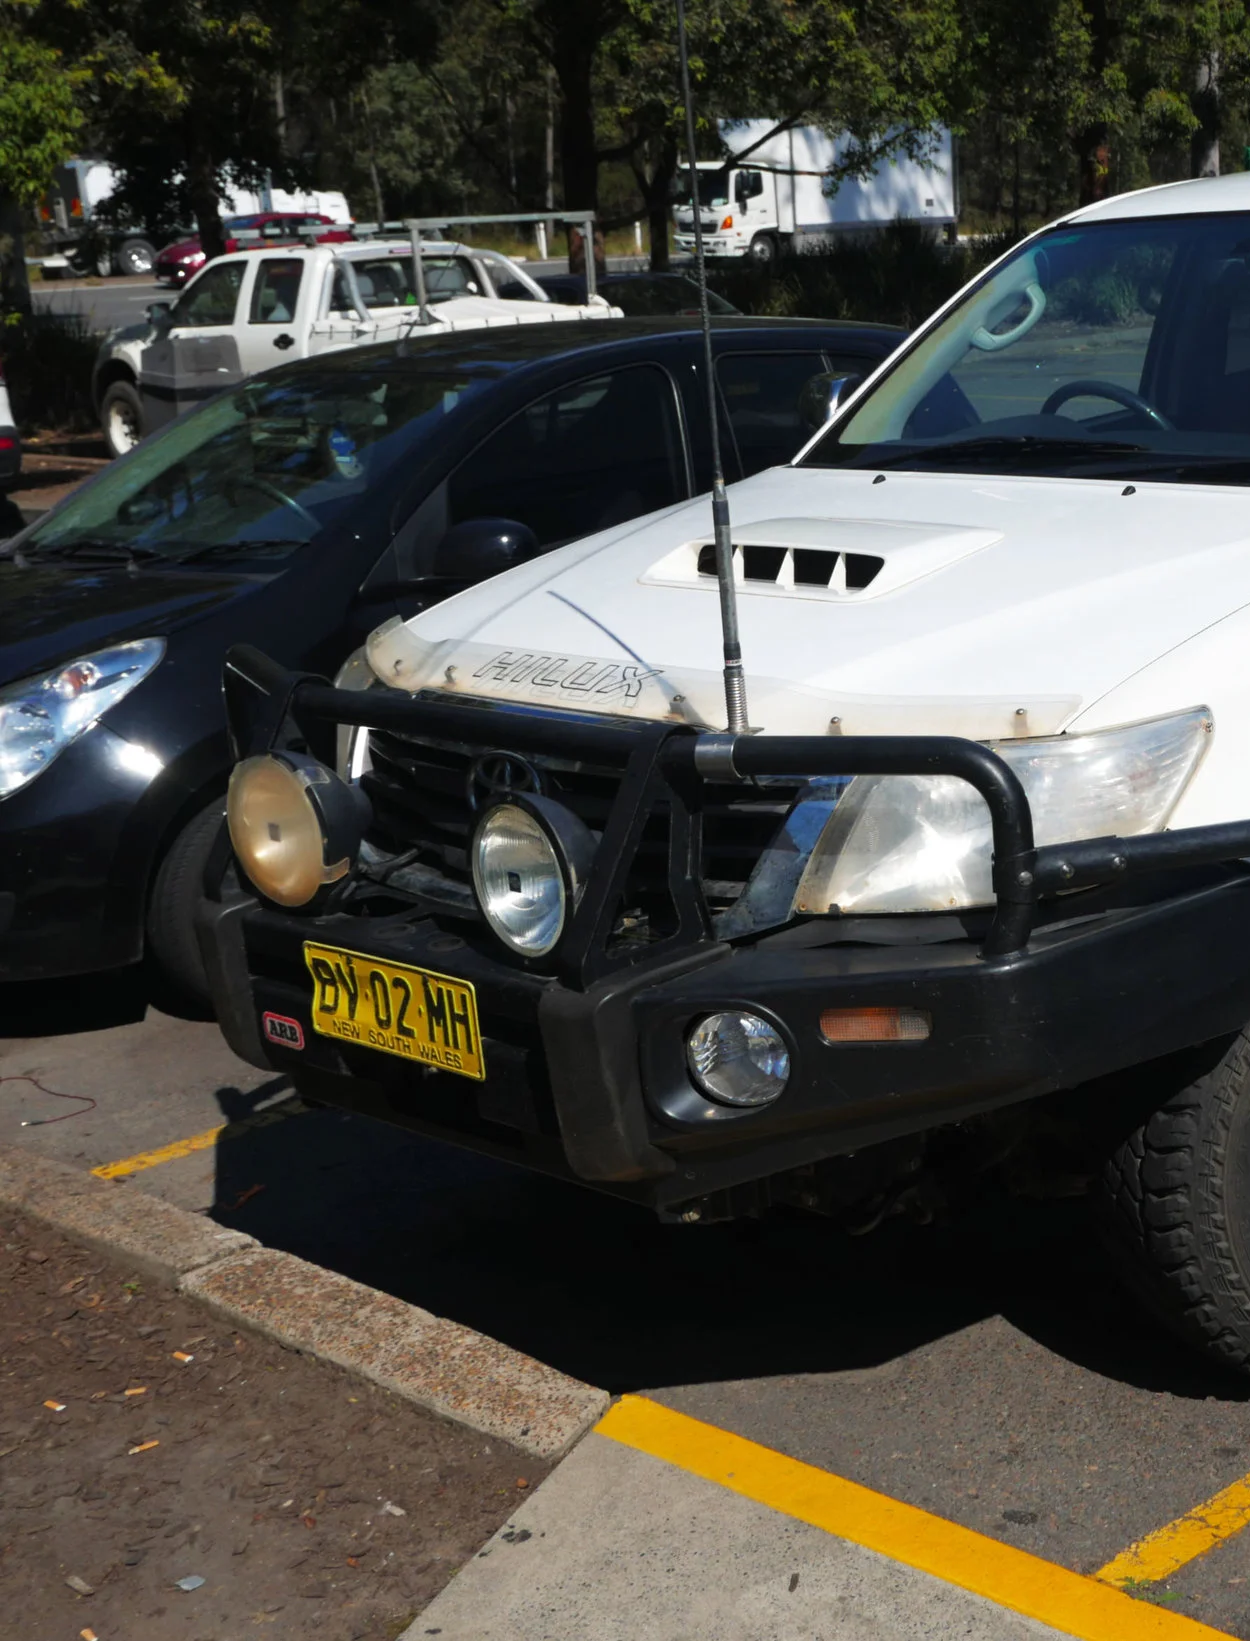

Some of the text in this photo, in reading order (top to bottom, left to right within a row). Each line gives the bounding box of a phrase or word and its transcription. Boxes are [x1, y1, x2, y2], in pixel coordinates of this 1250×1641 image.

[472, 651, 664, 697] HILUX
[269, 1019, 299, 1043] ARB
[332, 1019, 463, 1069] NEW SOUTH WALES
